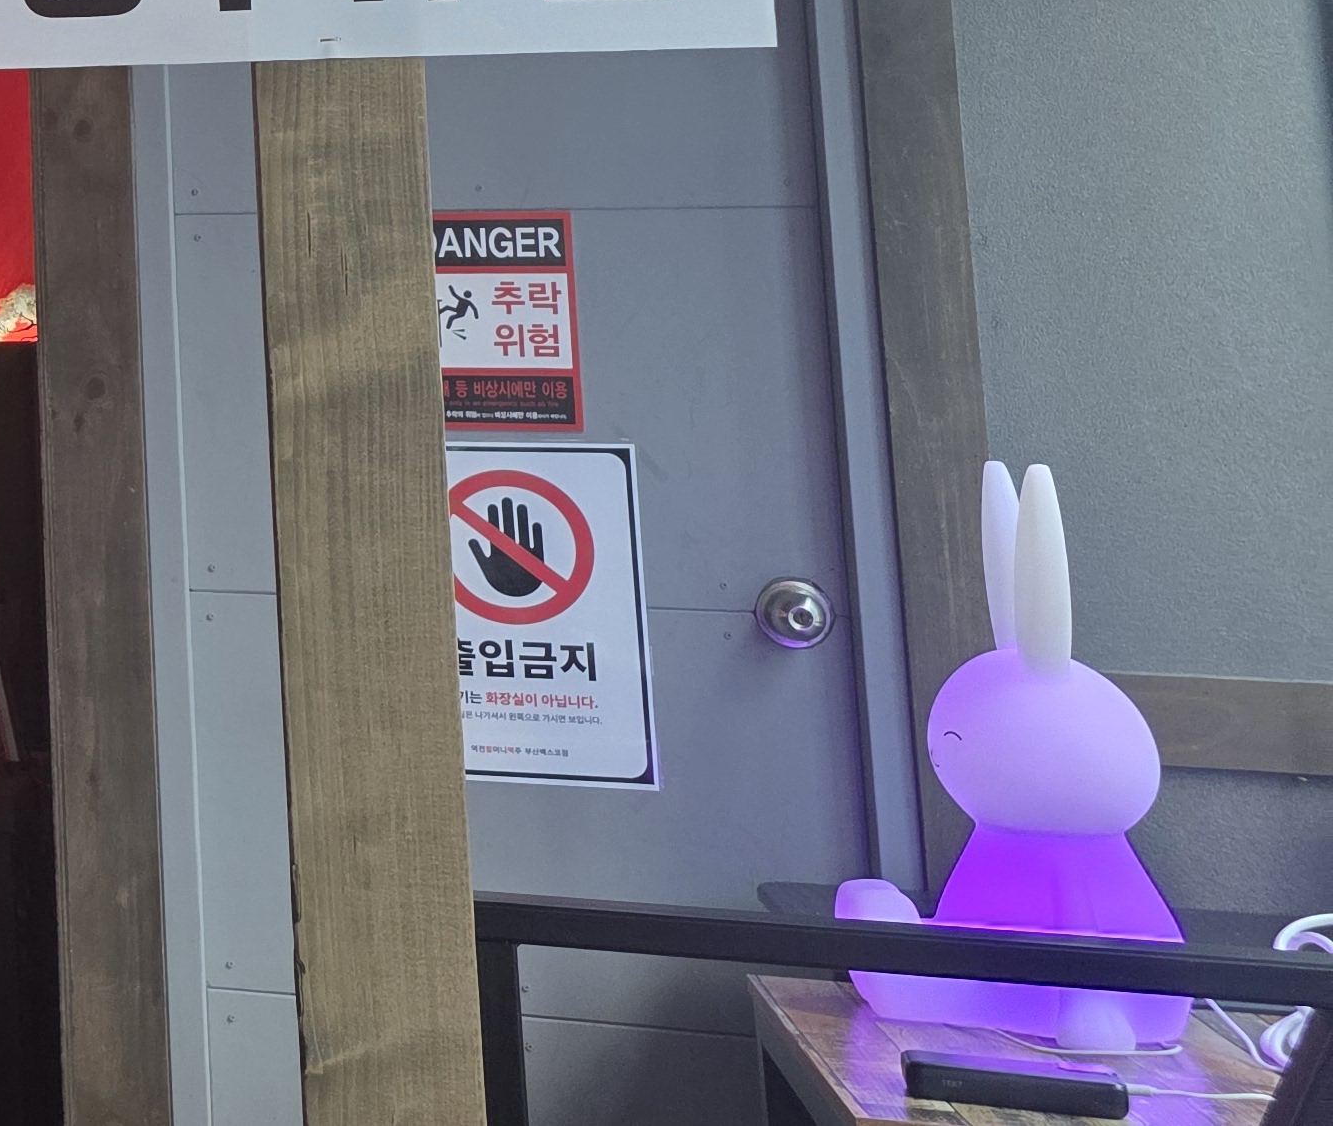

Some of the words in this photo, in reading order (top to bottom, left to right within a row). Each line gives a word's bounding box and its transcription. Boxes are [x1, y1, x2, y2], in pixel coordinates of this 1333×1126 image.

[433, 227, 562, 258] ANGER
[491, 281, 562, 315] 추락
[493, 323, 560, 358] 위험
[455, 379, 469, 399] 등
[473, 379, 537, 399] 비상시에만
[541, 380, 568, 400] 이용
[485, 691, 538, 707] 화장실이
[541, 693, 599, 709] 아닙니다.
